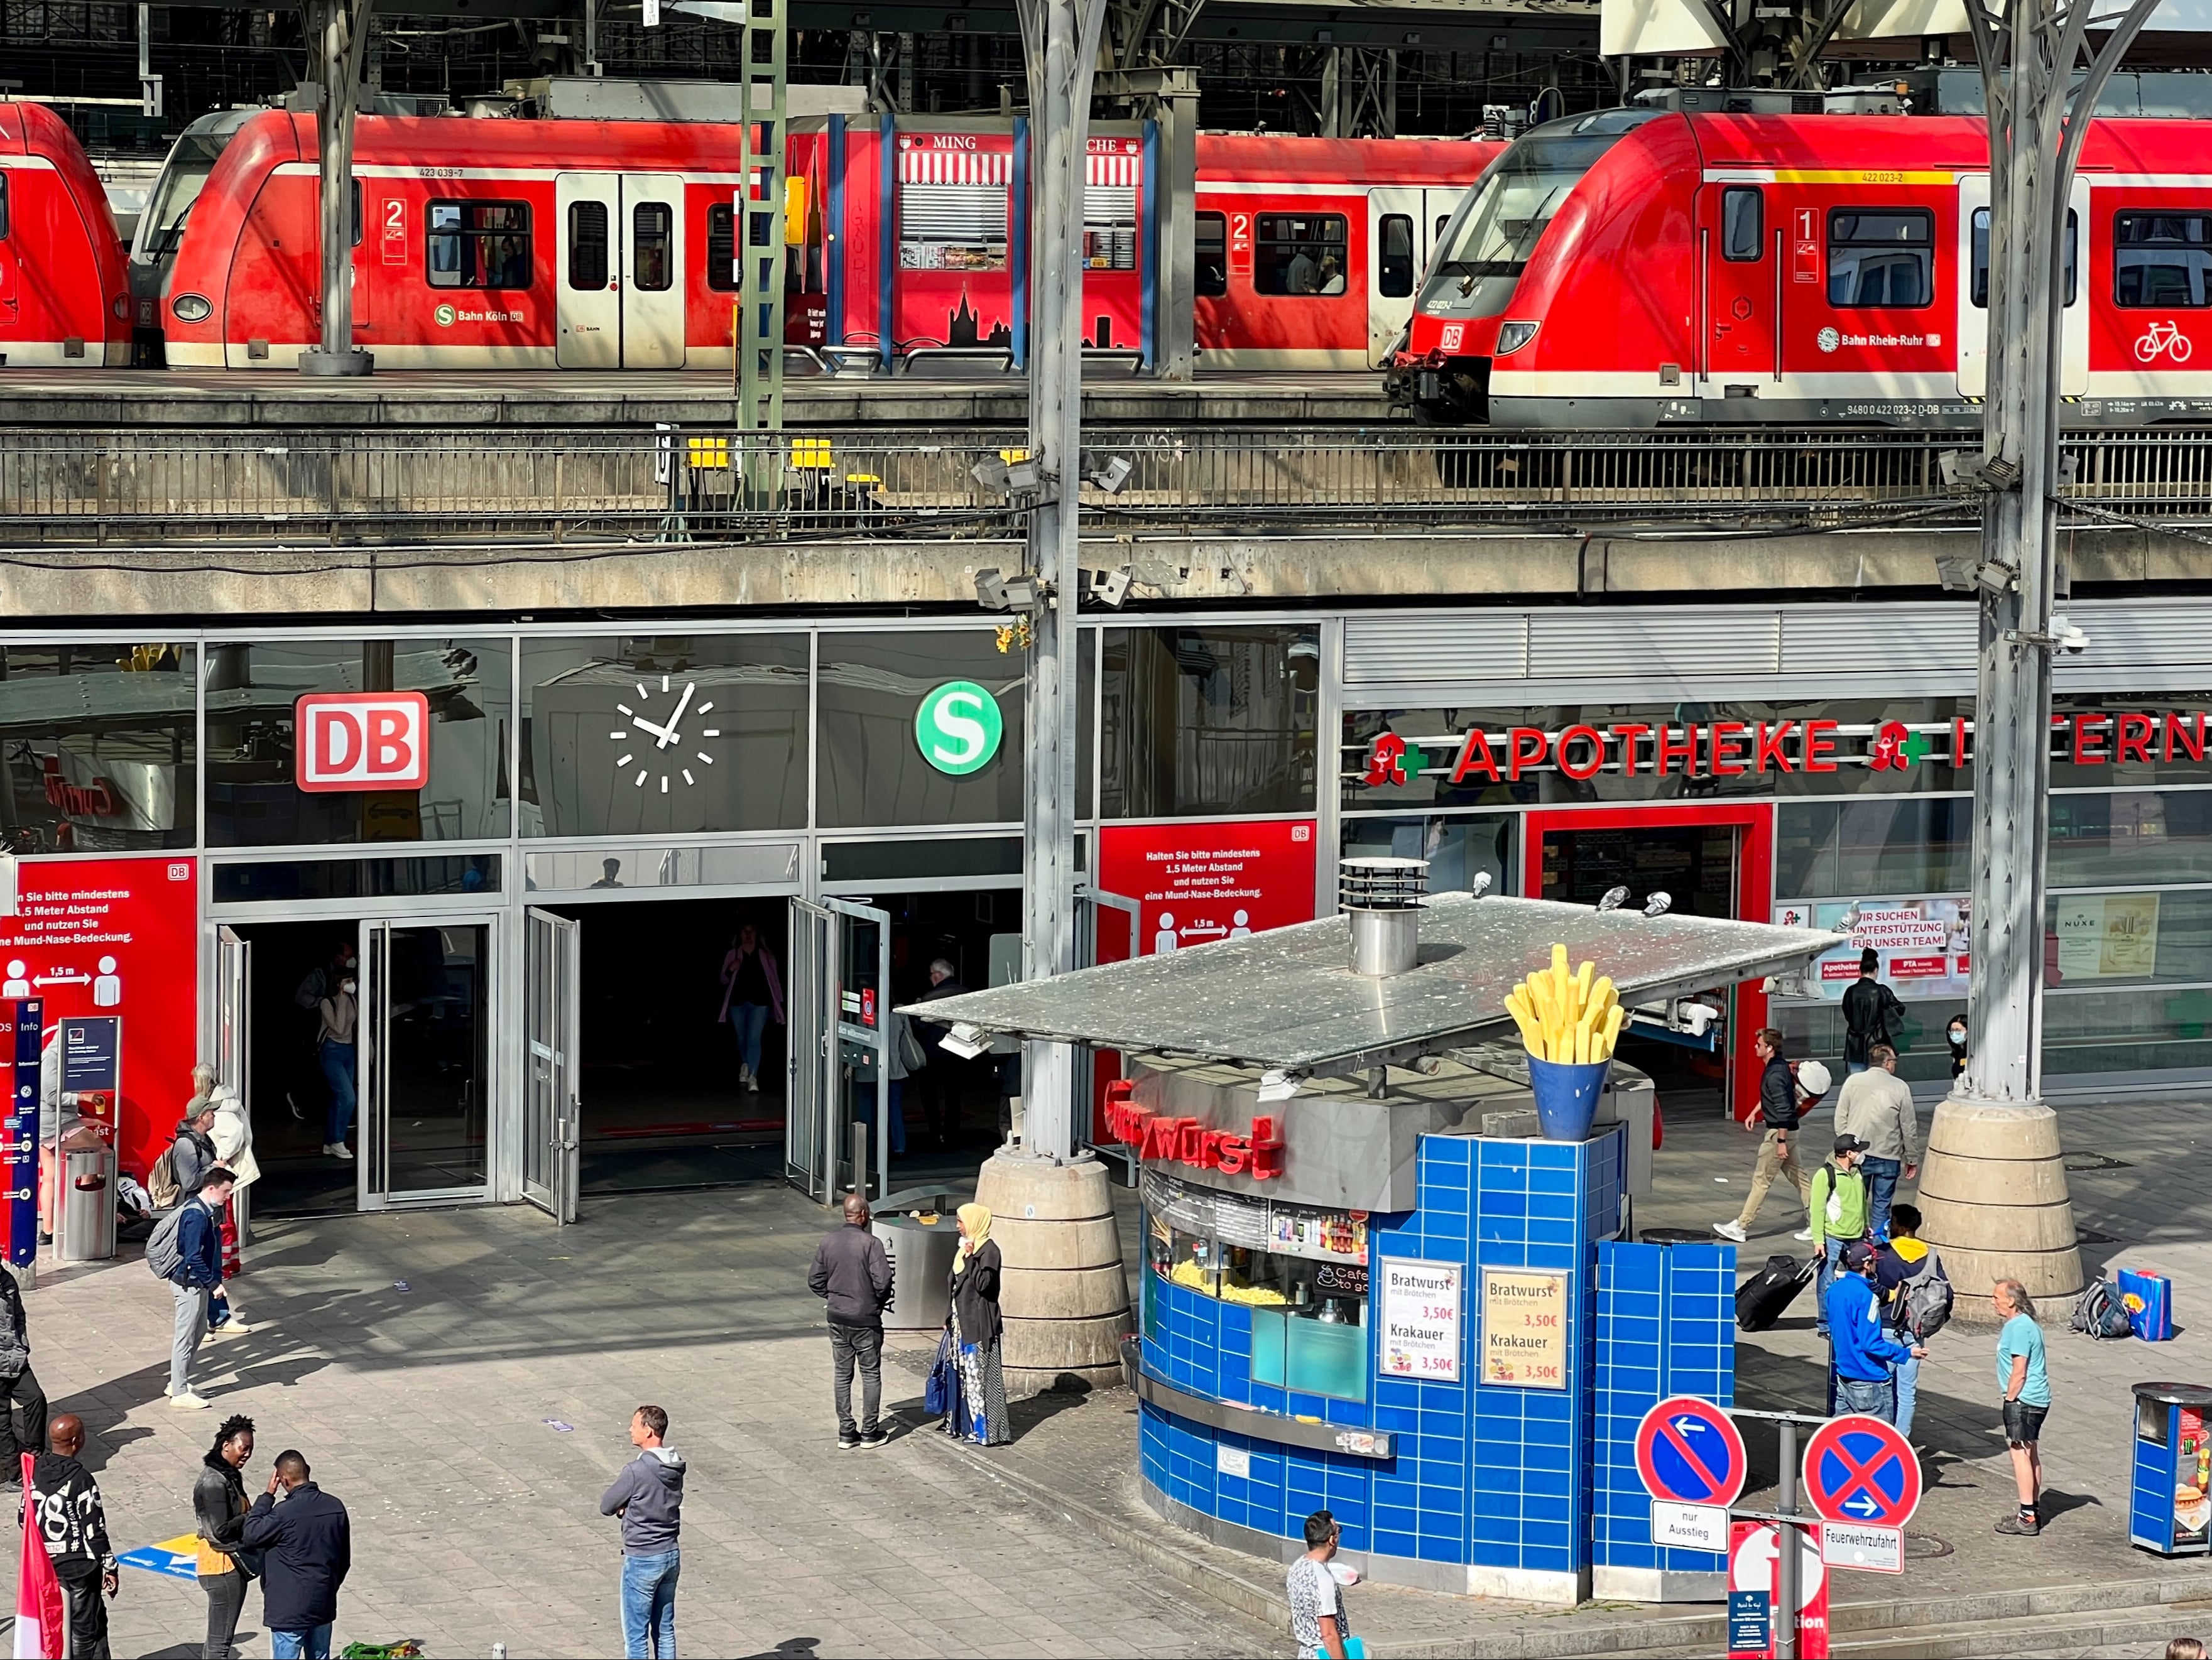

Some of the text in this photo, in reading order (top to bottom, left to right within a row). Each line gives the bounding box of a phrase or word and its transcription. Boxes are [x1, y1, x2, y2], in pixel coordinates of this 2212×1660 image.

[933, 136, 976, 149] MING
[1086, 139, 1116, 152] CHE
[419, 168, 464, 178] 423 039-7
[1862, 173, 1904, 182] 422 023-2
[386, 201, 403, 227] 2
[1233, 214, 1248, 239] 2
[1800, 210, 1811, 239] 1
[438, 307, 452, 324] S
[458, 311, 483, 322] Bahn
[486, 311, 508, 322] Köln
[1443, 328, 1460, 347] DB
[1841, 334, 1867, 345] Bahn
[1869, 334, 1924, 346] Rhein-Ruhr
[1847, 405, 1868, 415] 9480
[1870, 405, 1875, 415] 0
[1876, 405, 1892, 415] 422
[1893, 405, 1917, 415] 023-2
[1919, 405, 1939, 416] D-DB
[934, 692, 984, 764] S
[315, 710, 411, 774] DB
[1450, 712, 2206, 783] APOTHEKE IERN
[1294, 829, 1307, 838] DB
[1147, 849, 1261, 861] Halten Sie bitte mindestens
[171, 867, 185, 877] DB
[1165, 862, 1243, 874] 1,5 Meter Abstand
[1174, 876, 1235, 887] und nutzen Sie
[26, 892, 43, 902] Sie
[45, 891, 68, 901] bitte
[71, 889, 130, 900] mindestens
[1145, 889, 1262, 901] eine Mund-Nase-Bedeckung.
[34, 906, 65, 916] Meter
[67, 904, 109, 915] Abstand
[1875, 911, 1918, 921] SUCHEN
[25, 918, 99, 931] und nutzen Sie
[1194, 919, 1214, 928] 1,5 m
[2064, 920, 2096, 928] NUXE
[0, 933, 133, 947] ne Mund-Nase-Bedeckung.
[1875, 938, 1910, 947] UNSER
[1912, 936, 1944, 946] TEAM!
[50, 967, 74, 977] 1,5 m
[21, 1023, 38, 1031] Info
[1336, 1267, 1369, 1281] Cafe
[1338, 1279, 1351, 1289] to
[1391, 1272, 1450, 1290] Bratwurst
[1403, 1289, 1436, 1299] Brötchen
[1490, 1283, 1553, 1298] Bratwurst
[1505, 1299, 1539, 1307] Brötchen
[1422, 1306, 1453, 1320] 3,50€
[1524, 1314, 1558, 1328] 3,50€
[1390, 1323, 1444, 1341] Krakauer
[1390, 1338, 1436, 1350] mit Brötchen
[1490, 1333, 1548, 1349] Krakauer
[1504, 1350, 1539, 1358] Brötchen
[1422, 1357, 1453, 1371] 3,50€
[1525, 1365, 1559, 1379] 3,50€
[1682, 1513, 1698, 1522] nur
[1669, 1524, 1709, 1541] Ausstieg
[1826, 1529, 1897, 1549] Feuerwehrzufahrt
